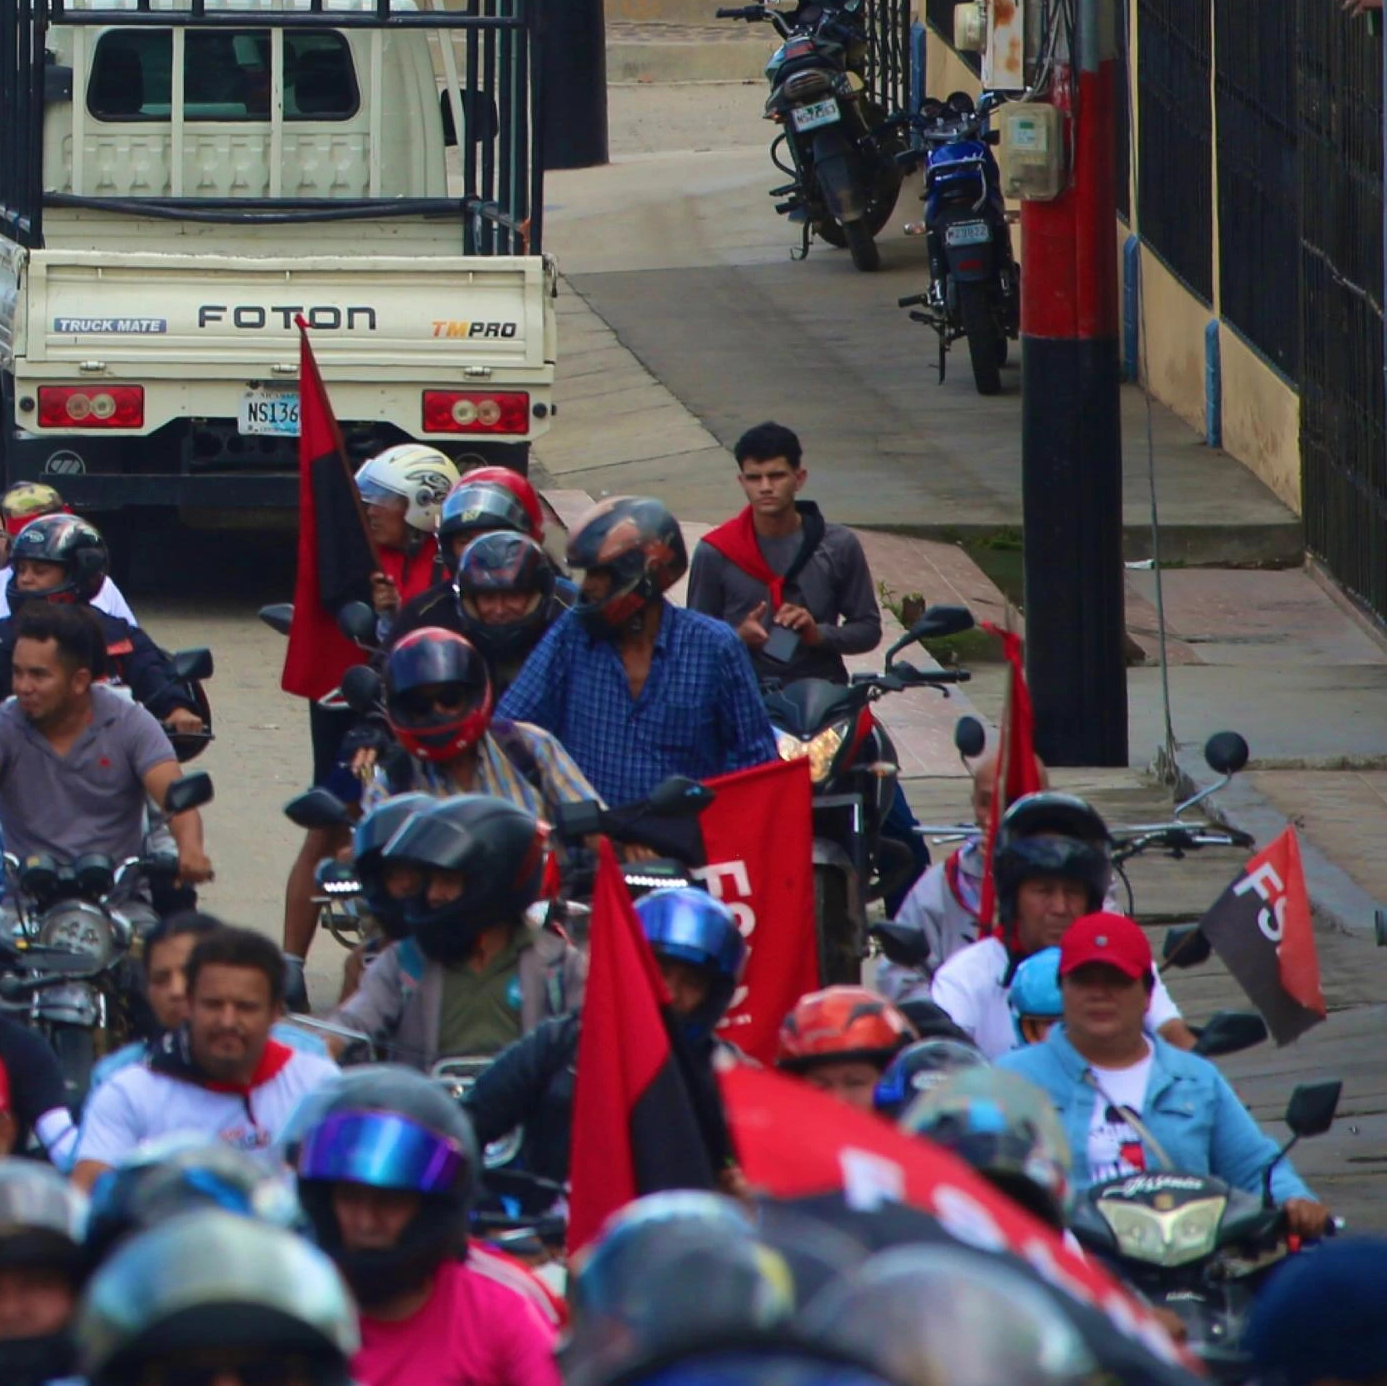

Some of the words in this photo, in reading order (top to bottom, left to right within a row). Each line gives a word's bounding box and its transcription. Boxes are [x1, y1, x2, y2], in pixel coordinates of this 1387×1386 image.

[59, 318, 113, 333] TRUCK
[117, 318, 161, 333] MATE
[197, 304, 377, 331] FOTON
